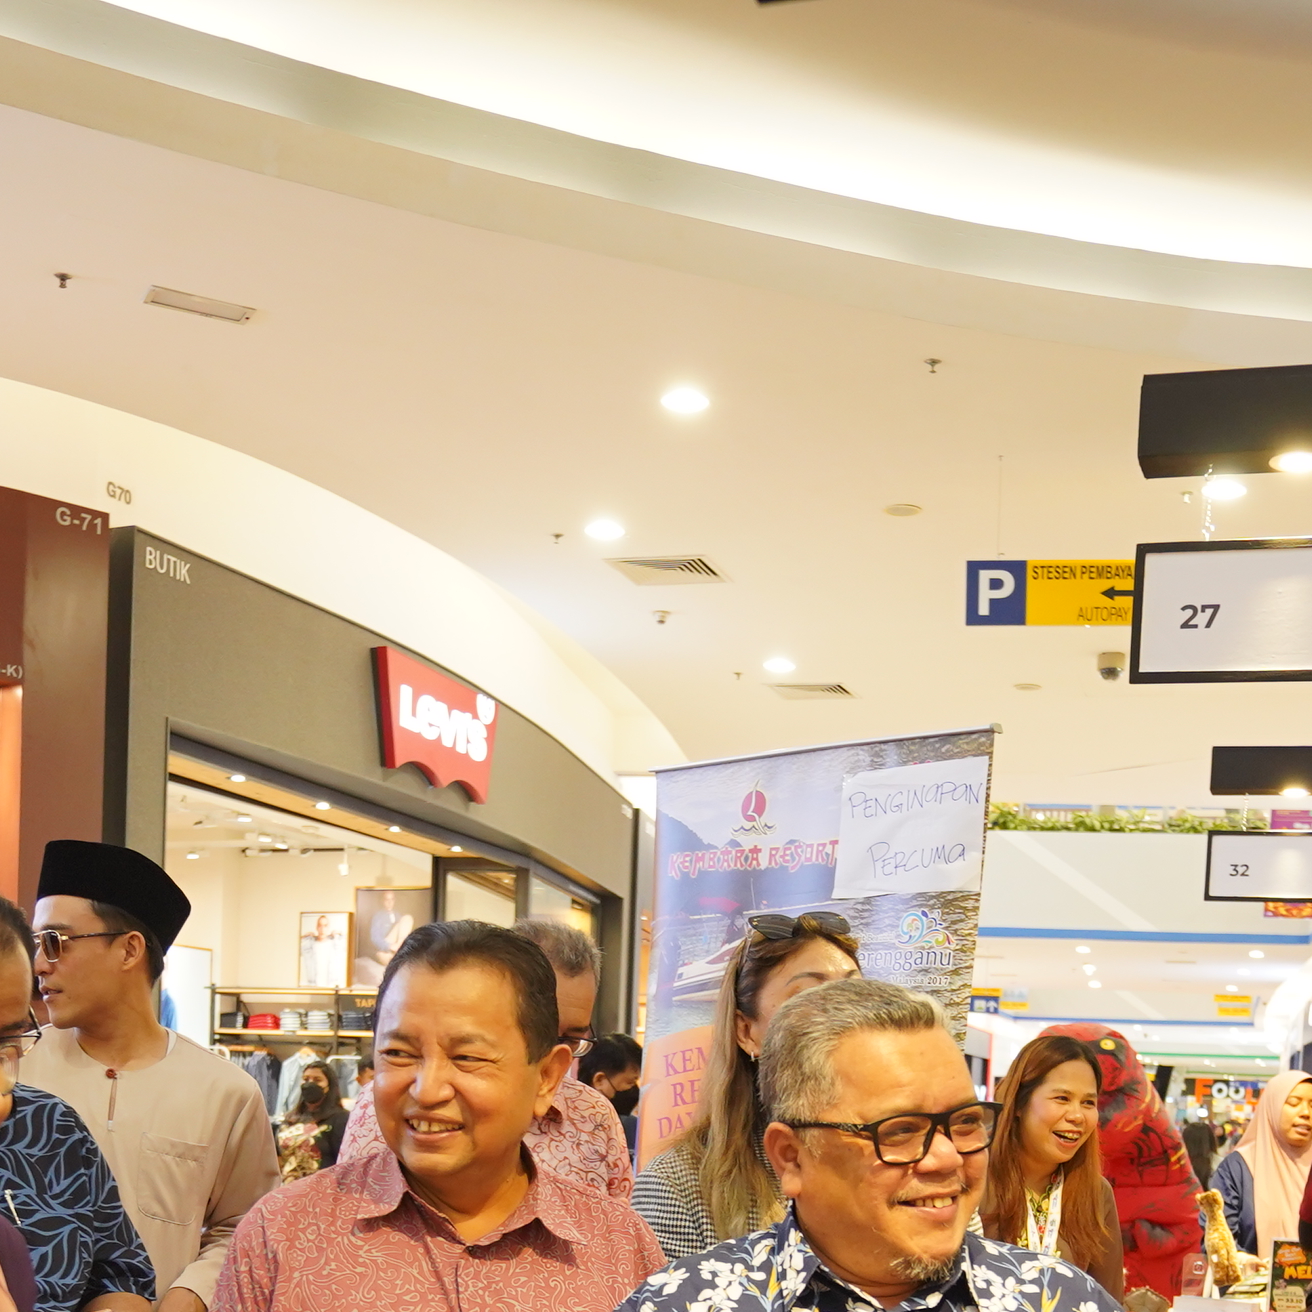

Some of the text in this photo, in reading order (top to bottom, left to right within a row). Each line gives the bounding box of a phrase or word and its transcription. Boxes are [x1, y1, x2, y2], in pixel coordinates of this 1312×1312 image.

[106, 480, 133, 506] G70
[54, 505, 104, 536] G-71
[144, 545, 192, 586] BUTIK
[1030, 564, 1134, 581] STESEN PEMBAYA
[1076, 606, 1131, 622] AUTOPAY
[1178, 603, 1222, 631] 27
[667, 838, 840, 880] KEMBARA RESORT
[1228, 863, 1251, 877] 32
[857, 949, 952, 972] erengganu
